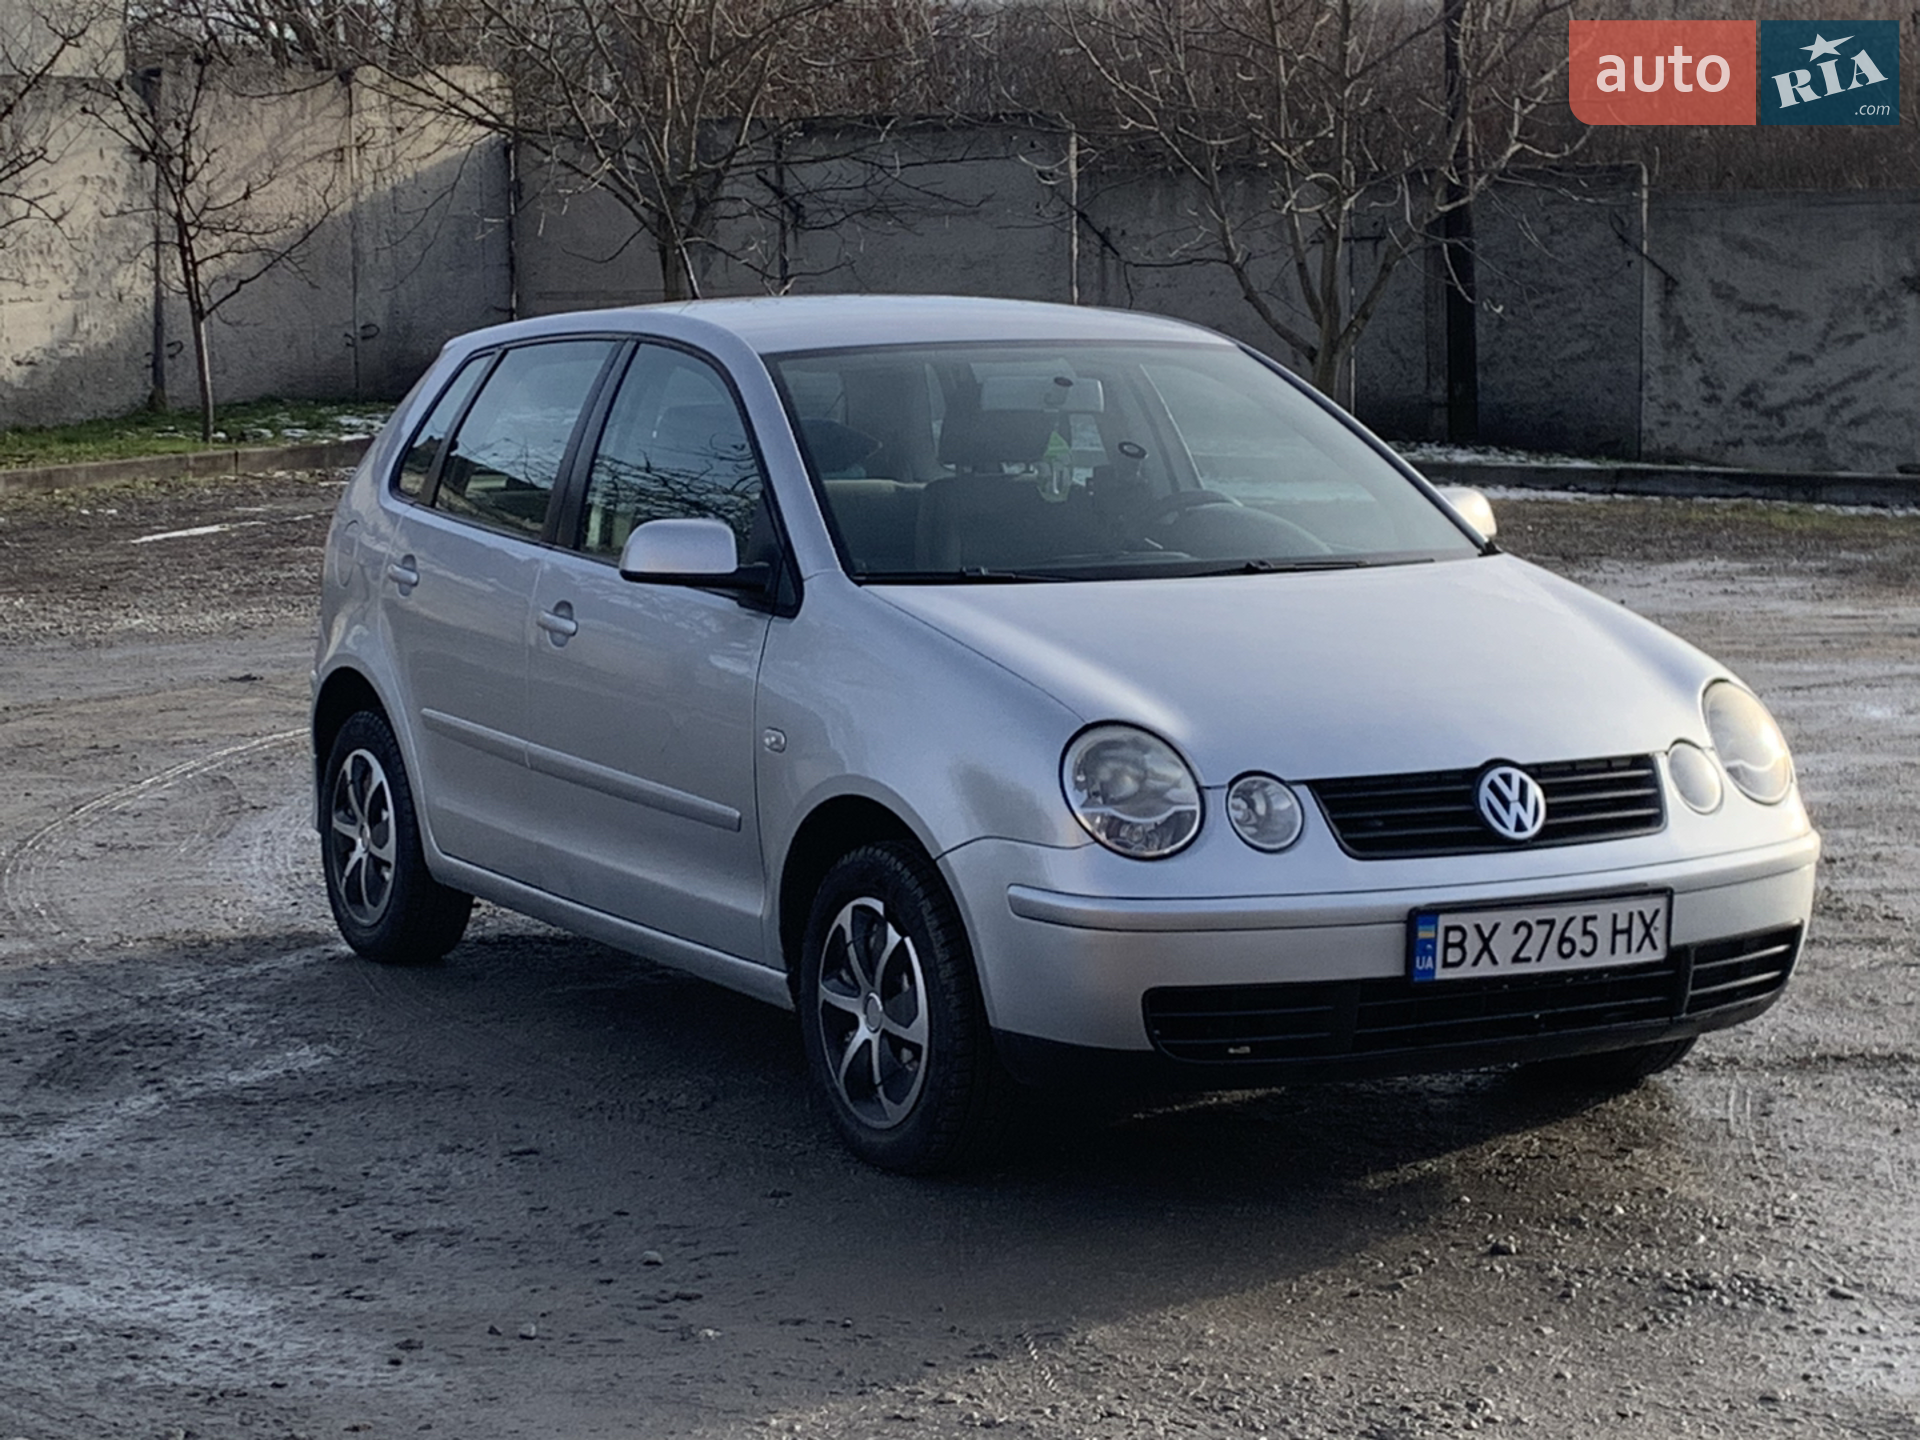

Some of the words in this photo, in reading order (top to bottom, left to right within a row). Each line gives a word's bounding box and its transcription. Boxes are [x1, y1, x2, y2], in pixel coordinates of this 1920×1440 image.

[1441, 922, 1501, 969] BX
[1511, 914, 1599, 964] 2765
[1610, 908, 1661, 955] HX
[1415, 955, 1434, 970] UA
